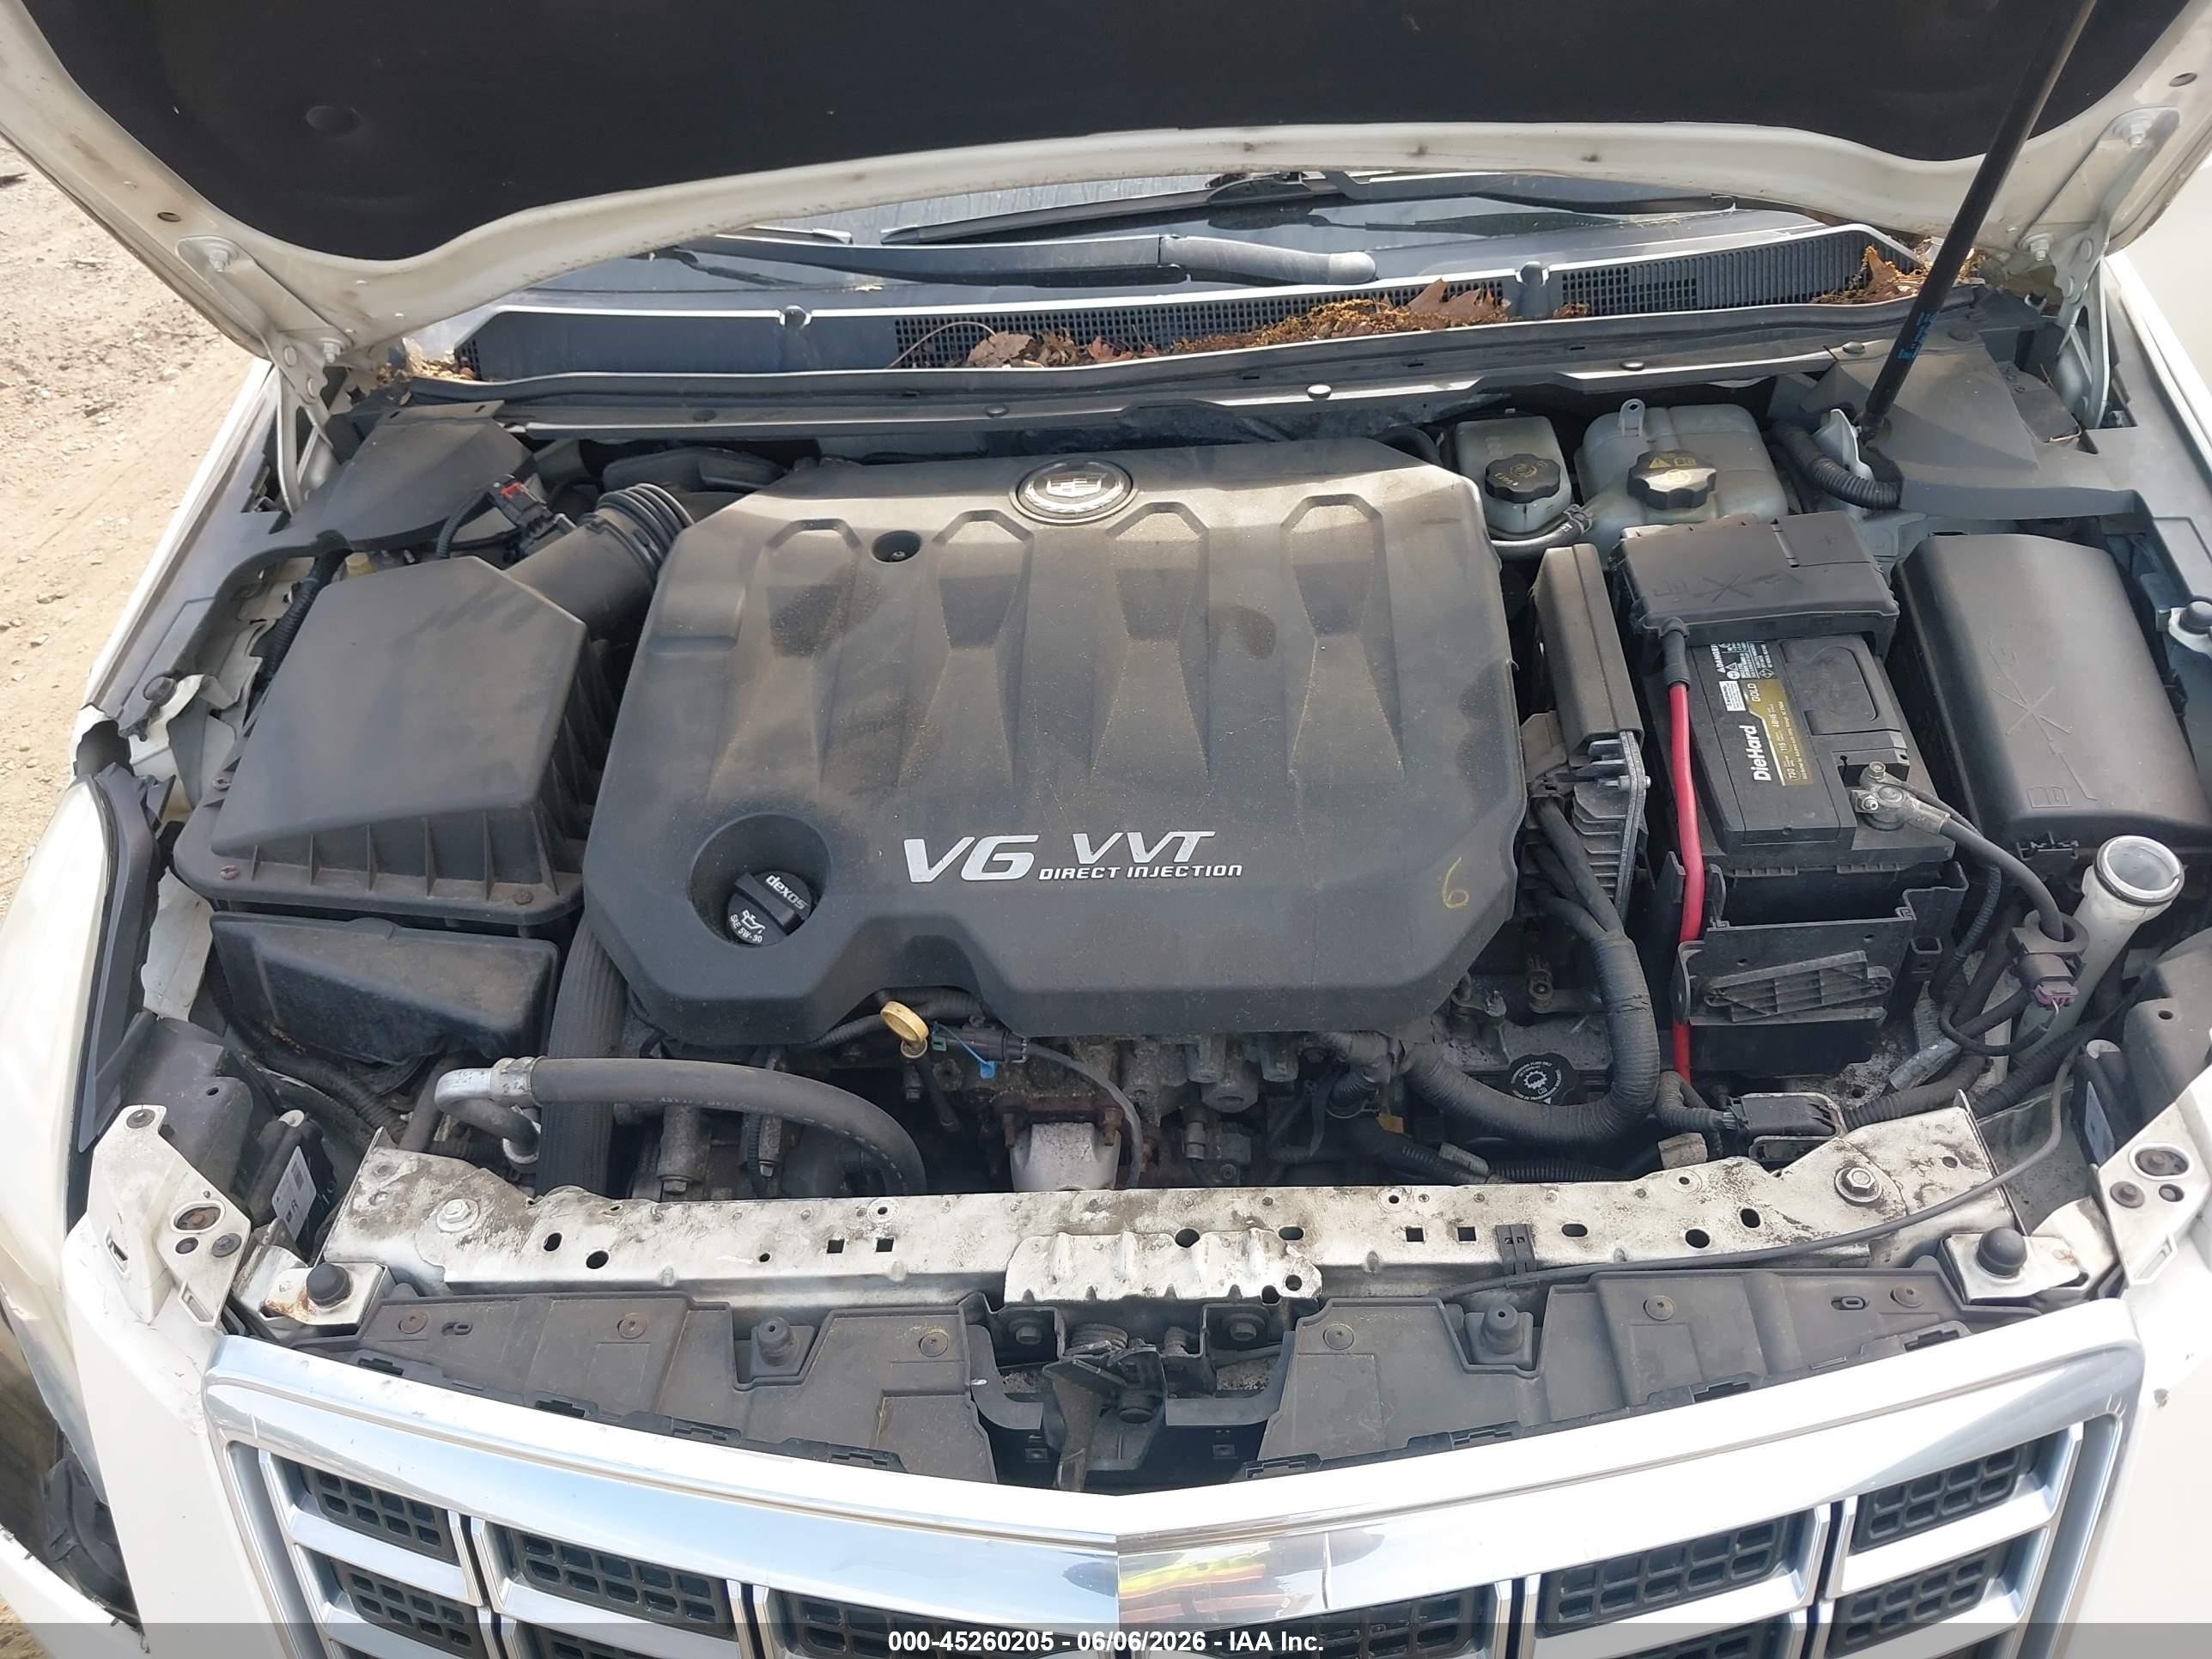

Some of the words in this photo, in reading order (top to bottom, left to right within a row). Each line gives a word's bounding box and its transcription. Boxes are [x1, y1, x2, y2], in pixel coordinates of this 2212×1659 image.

[1747, 683, 1761, 702] GOLD
[1738, 725, 1772, 781] DieHard
[903, 835, 1039, 883] V6
[1073, 831, 1216, 865] VVT
[1038, 867, 1121, 880] DIRECT
[1127, 865, 1243, 878] INJECTION
[765, 875, 809, 909] dexos
[1442, 856, 1469, 908] 6
[730, 915, 742, 929] SAE
[738, 927, 763, 943] 5W-30
